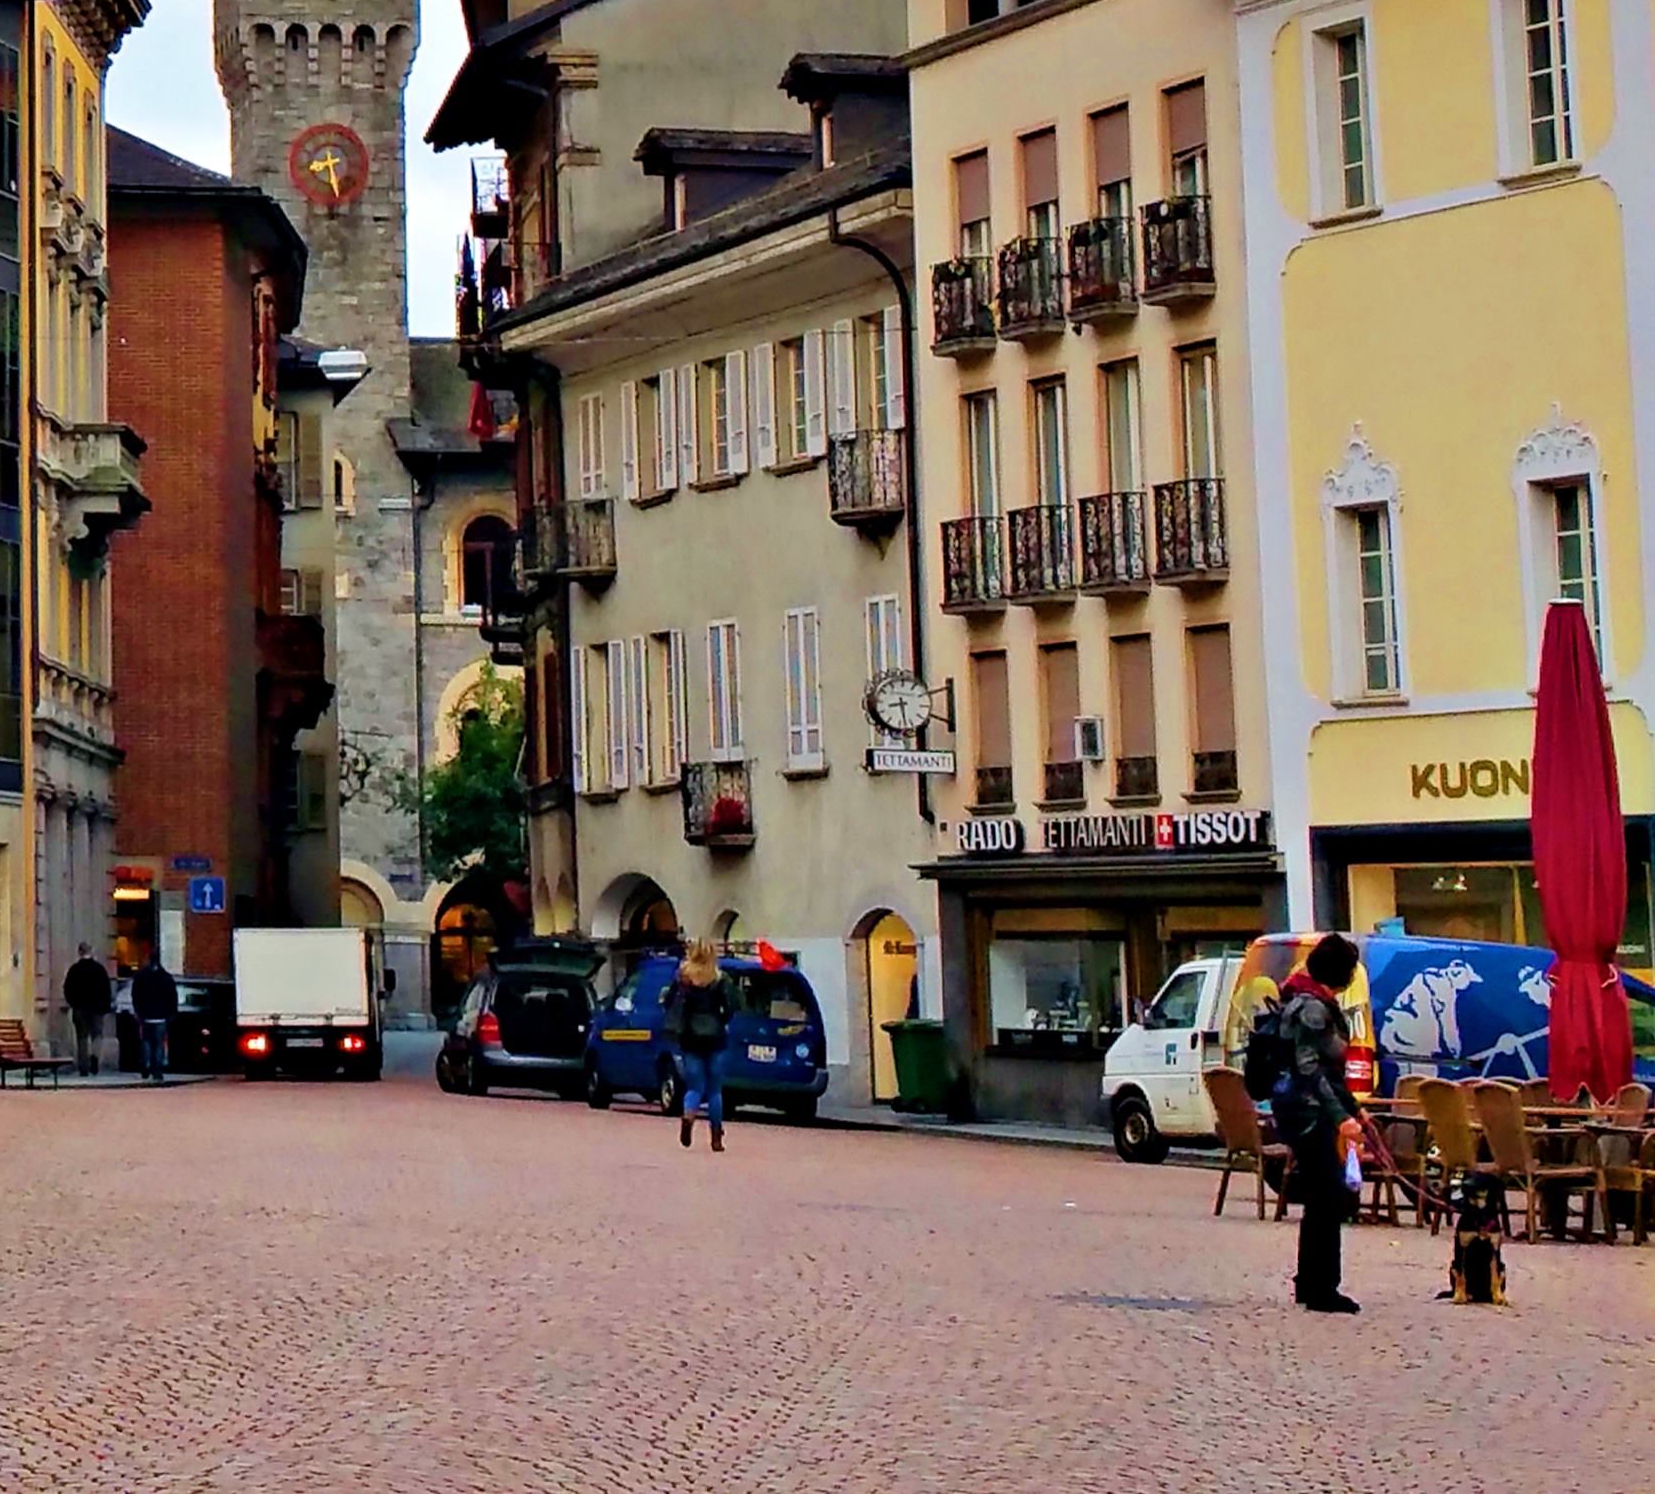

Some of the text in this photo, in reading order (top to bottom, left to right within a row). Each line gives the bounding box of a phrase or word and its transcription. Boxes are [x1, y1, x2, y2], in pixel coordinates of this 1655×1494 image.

[876, 754, 951, 767] TETTAMANTI
[956, 819, 1017, 850] RADO
[1041, 815, 1146, 848] TETTAMANTI
[1172, 810, 1262, 845] TISSOT
